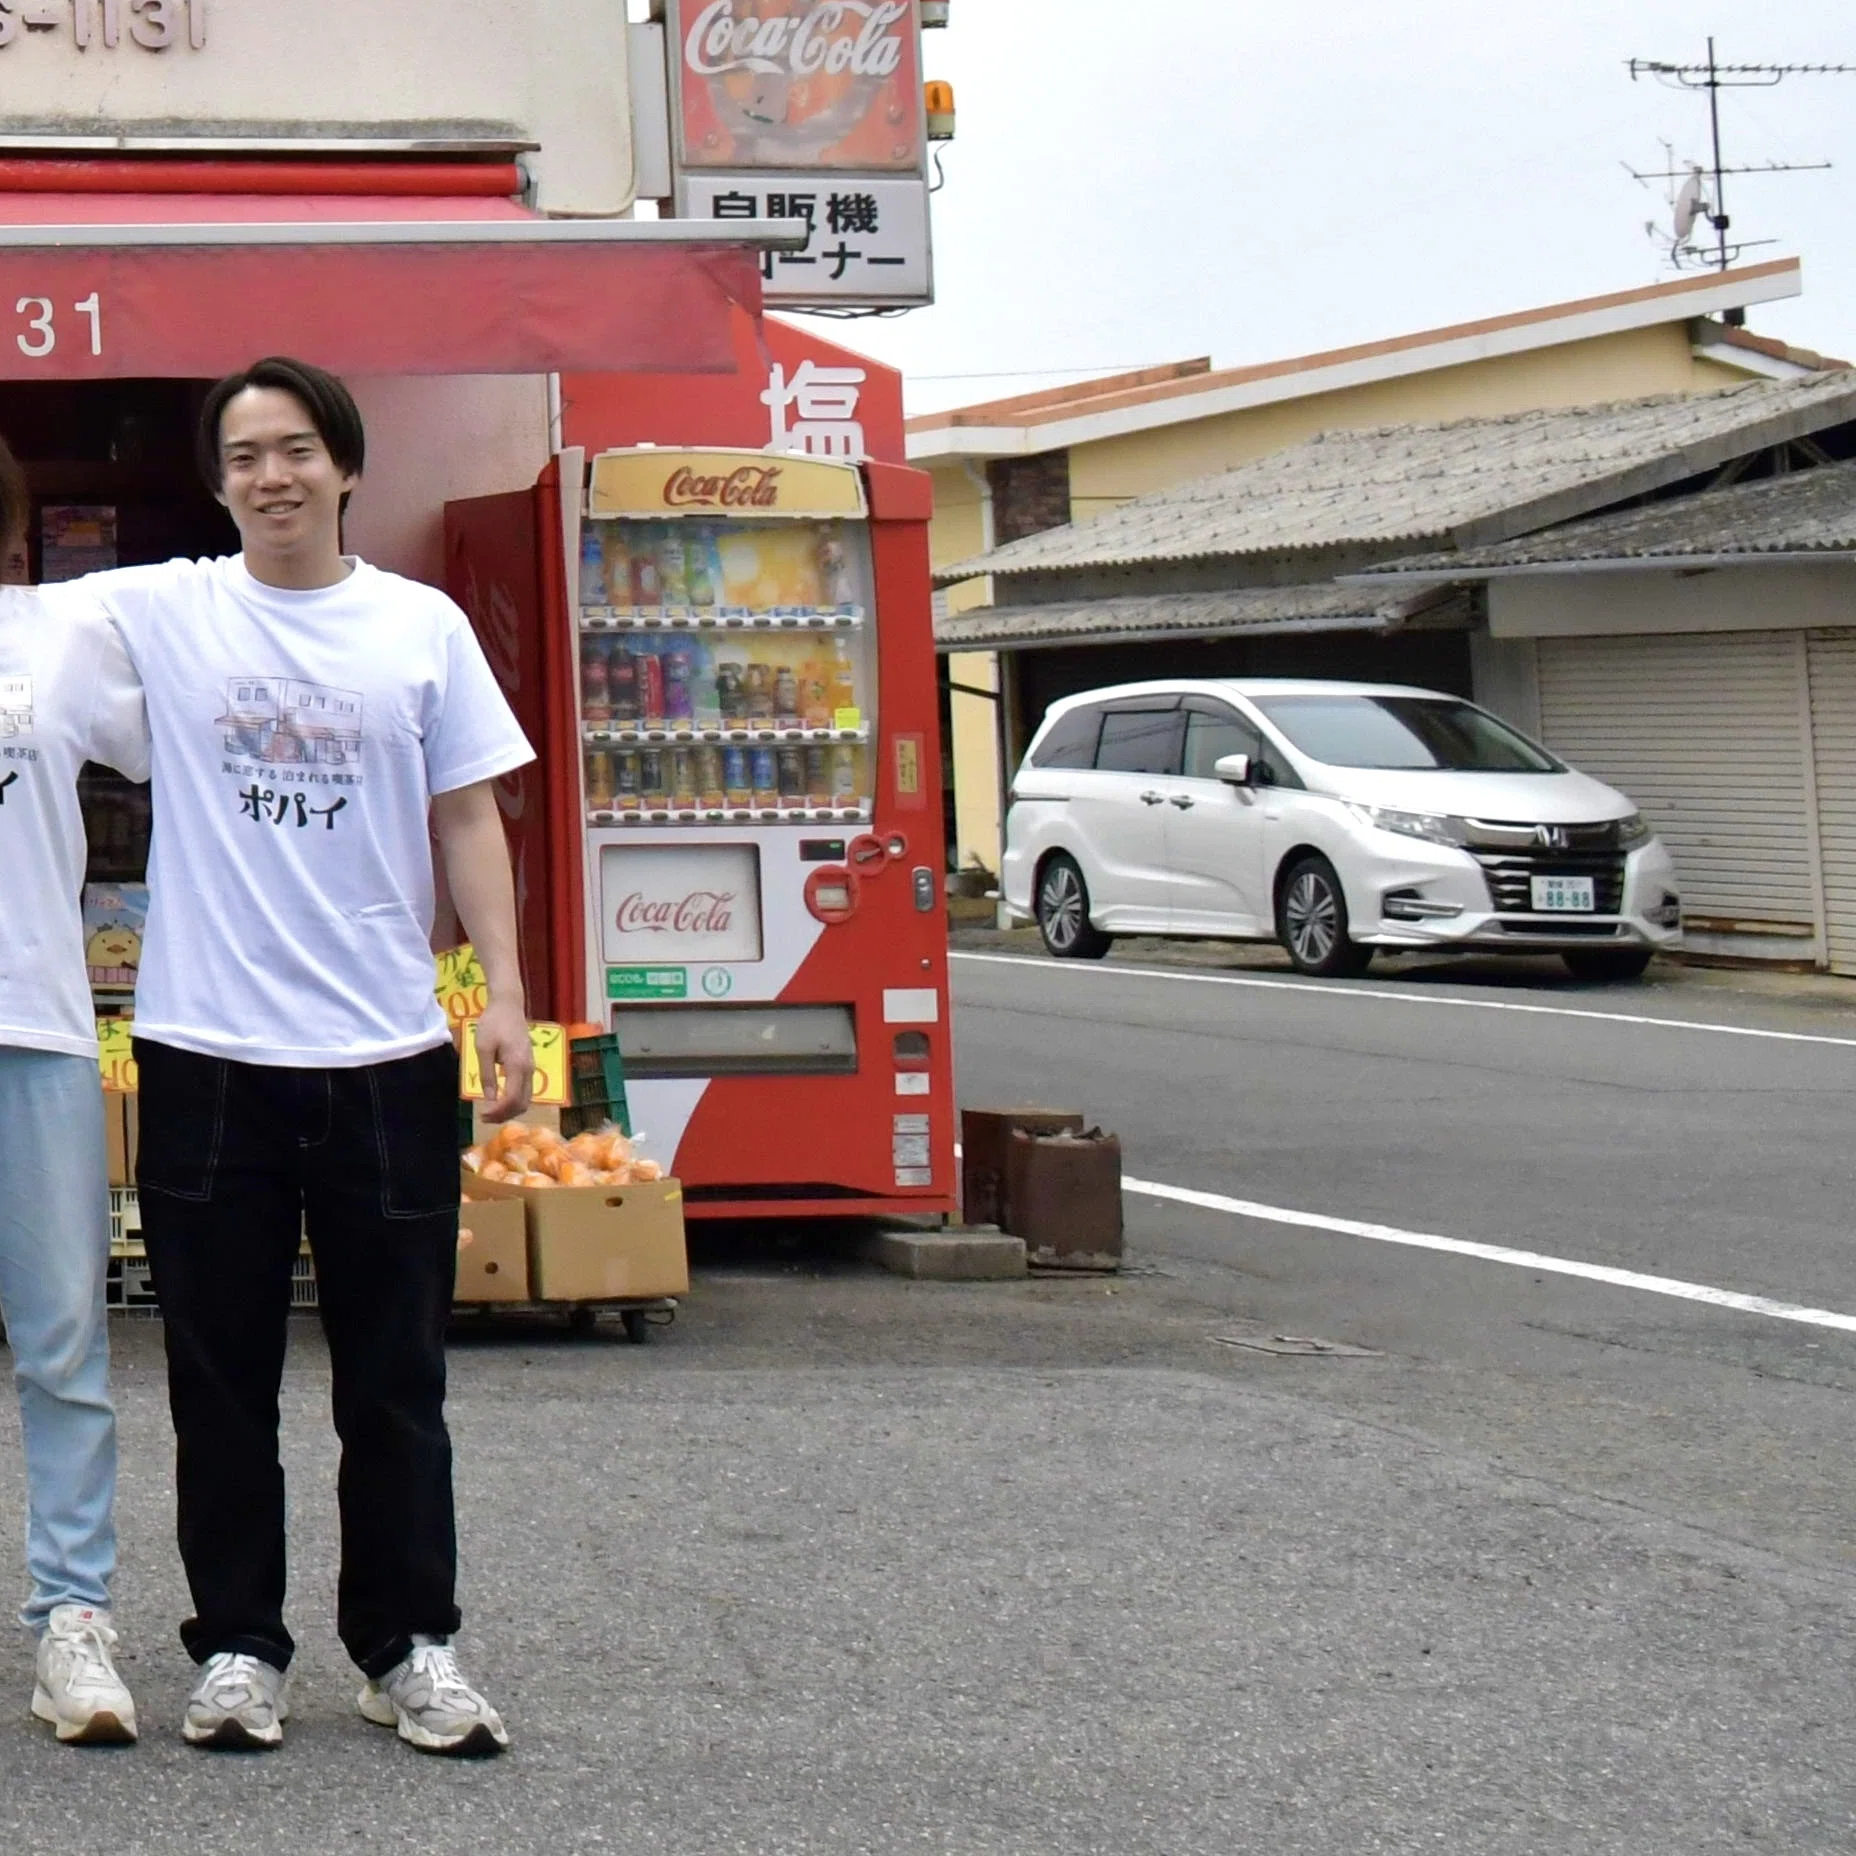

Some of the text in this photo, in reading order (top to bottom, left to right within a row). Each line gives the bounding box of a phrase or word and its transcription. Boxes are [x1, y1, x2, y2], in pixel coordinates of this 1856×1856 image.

[760, 359, 867, 465] 塩
[239, 784, 347, 830] ポパイ
